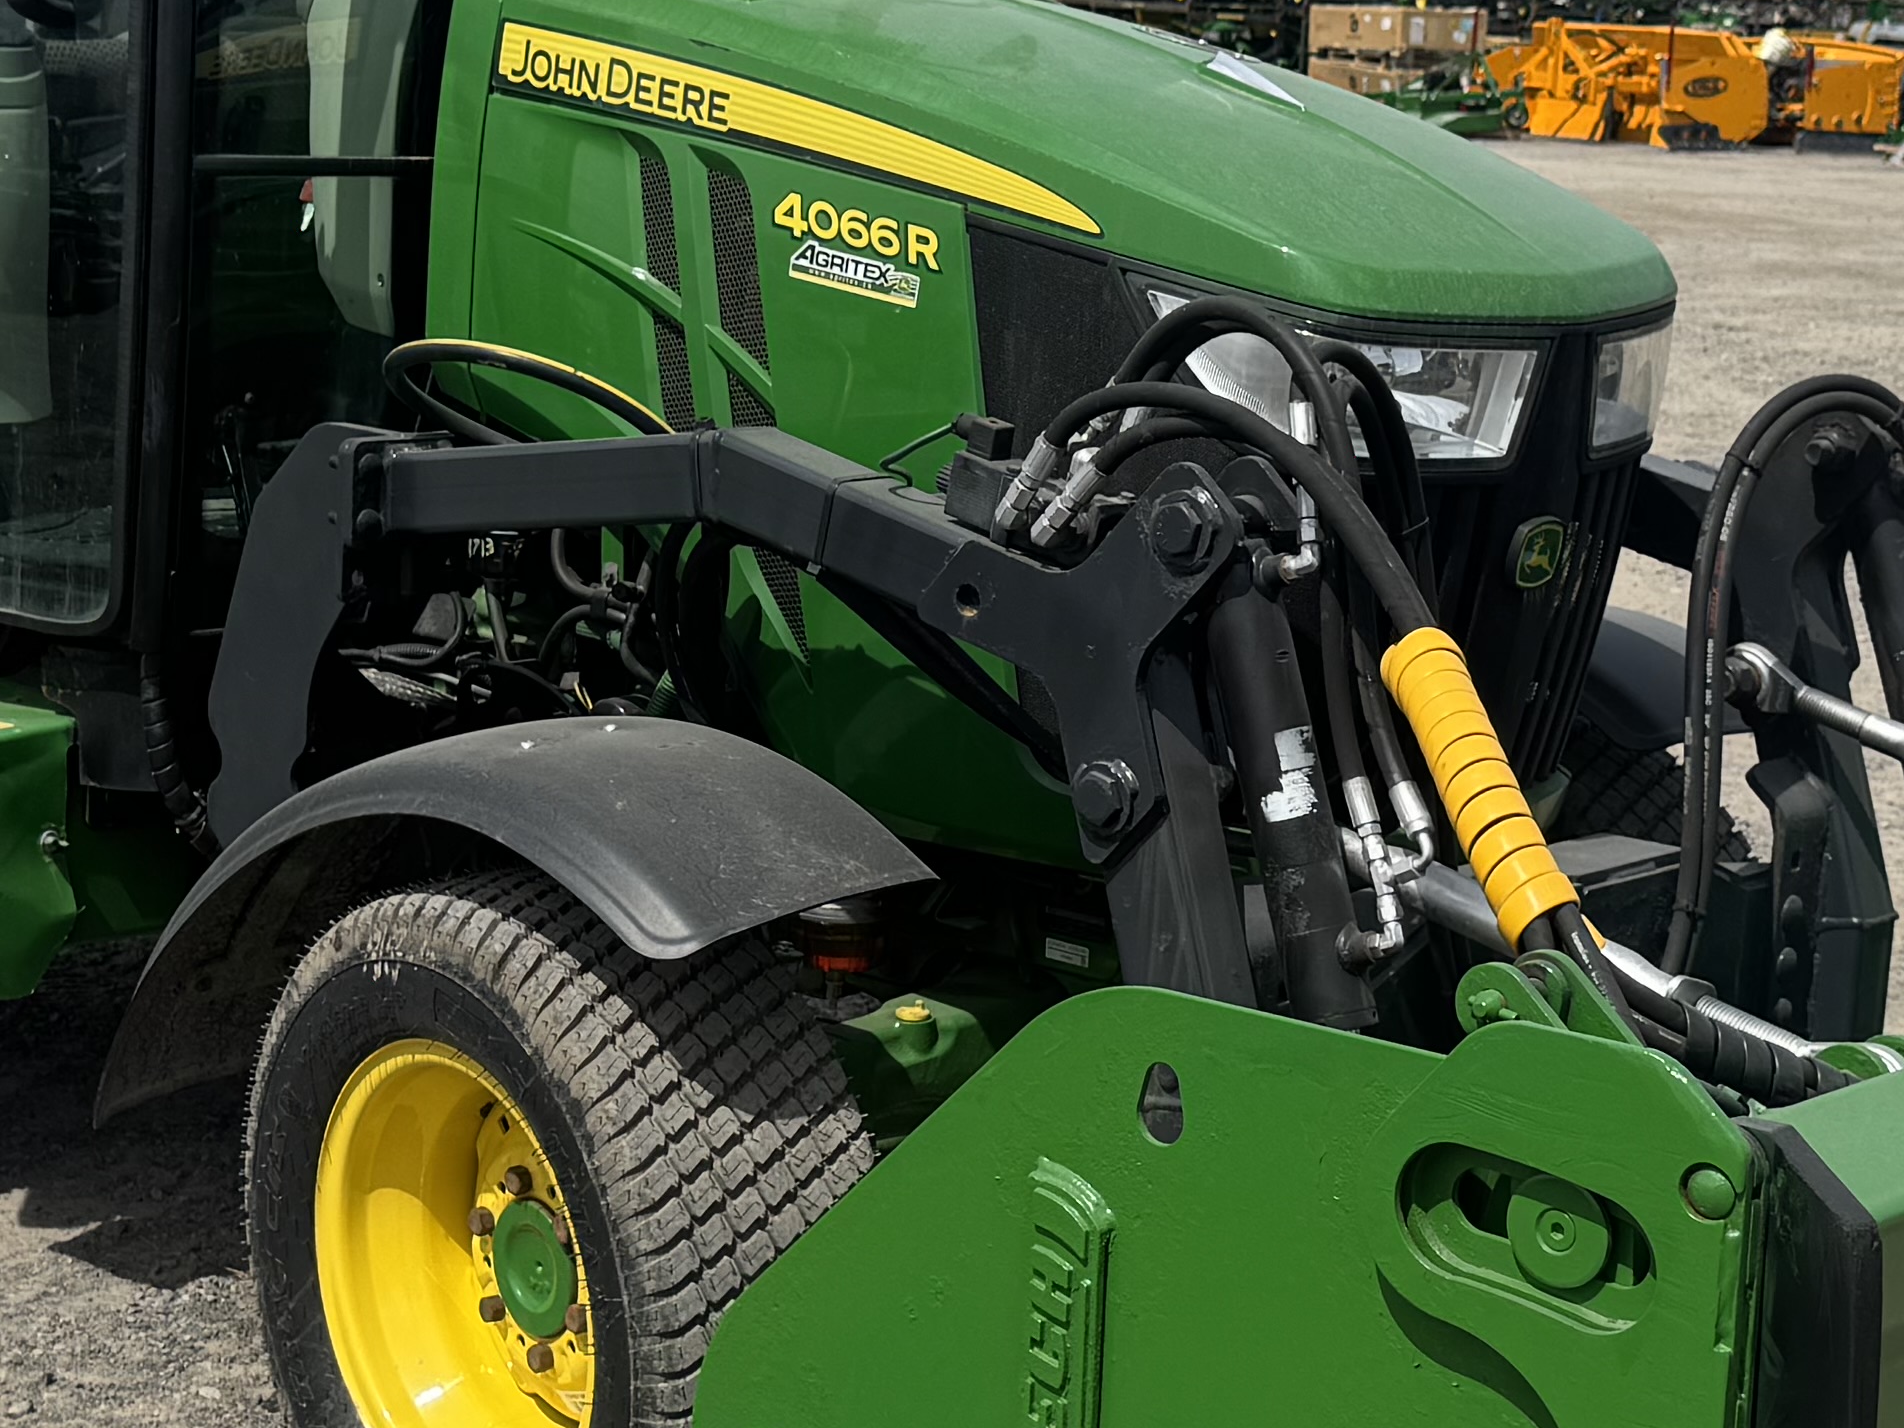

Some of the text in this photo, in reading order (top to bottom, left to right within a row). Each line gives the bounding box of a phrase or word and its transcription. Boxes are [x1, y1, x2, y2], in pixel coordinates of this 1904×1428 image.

[511, 39, 730, 126] JOHN DEERE
[794, 243, 891, 284] AGRITEX
